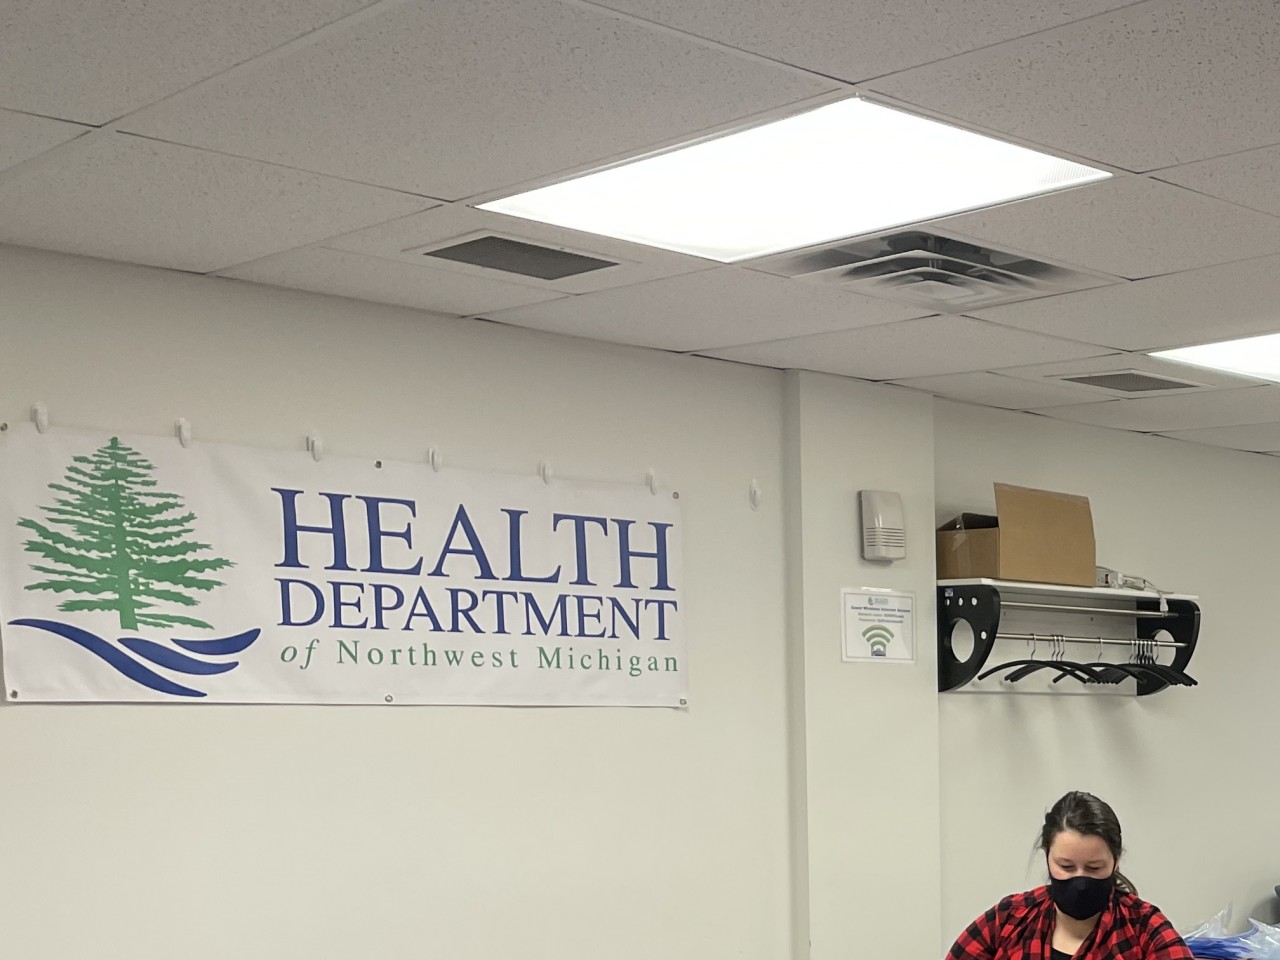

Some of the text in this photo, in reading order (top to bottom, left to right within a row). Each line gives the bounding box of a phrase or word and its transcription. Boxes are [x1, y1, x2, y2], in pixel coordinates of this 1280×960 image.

[272, 487, 677, 592] HEALTH
[277, 577, 679, 641] DEPARTMENT
[280, 639, 679, 677] of Northwest Michigan
